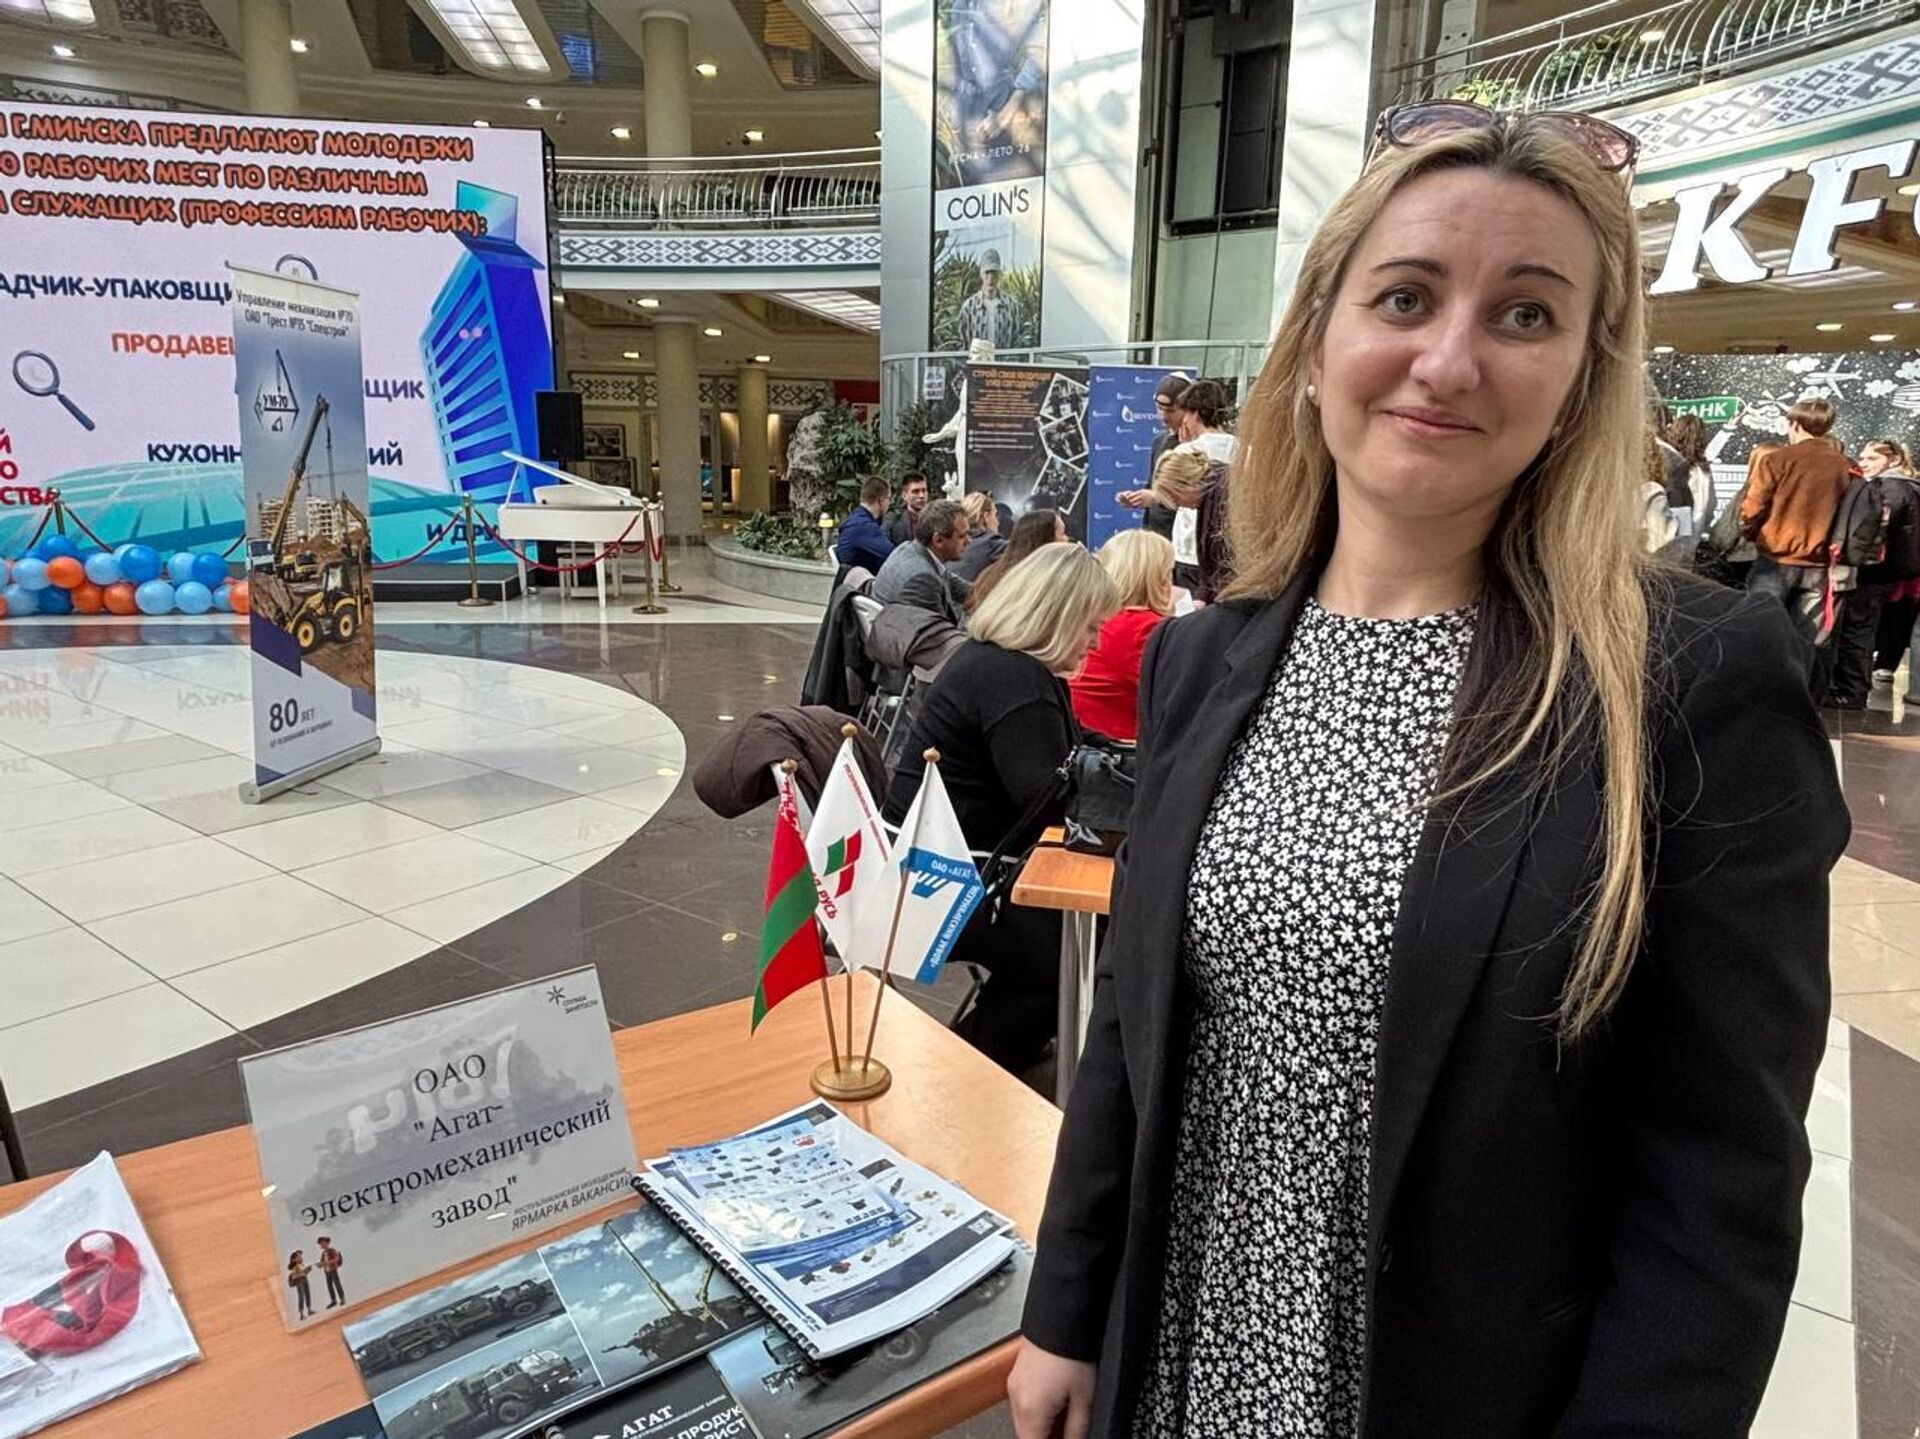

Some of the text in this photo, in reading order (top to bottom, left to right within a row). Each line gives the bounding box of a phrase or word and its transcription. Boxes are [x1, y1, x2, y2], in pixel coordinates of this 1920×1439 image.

[11, 113, 146, 145] Г.МИНСКА
[149, 122, 318, 154] ПРЕДЛАГАЮТ
[322, 130, 474, 163] МОЛОДЕЖИ
[24, 152, 151, 184] РАБОЧИХ
[154, 160, 221, 187] МЕСТ
[224, 164, 264, 189] ПО
[268, 166, 428, 195] РАЗЛИЧНЫМ
[12, 189, 177, 224] СЛУЖАЩИХ
[180, 198, 358, 229] (ПРОФЕССИЯМ
[360, 206, 488, 237] РАБОЧИХ):
[947, 185, 1029, 220] COLIN'S
[1649, 138, 1920, 294] KF
[112, 333, 237, 358] ПРОДАВЕ
[1667, 402, 1728, 420] БАНК
[269, 698, 299, 732] 80
[415, 1054, 486, 1094] ОАО
[414, 1104, 503, 1142] "Агат-
[301, 1099, 611, 1227] электромеханический
[431, 1175, 517, 1229] завод"
[511, 1199, 569, 1231] ЯРМАРКА
[622, 1405, 673, 1438] АГАТ
